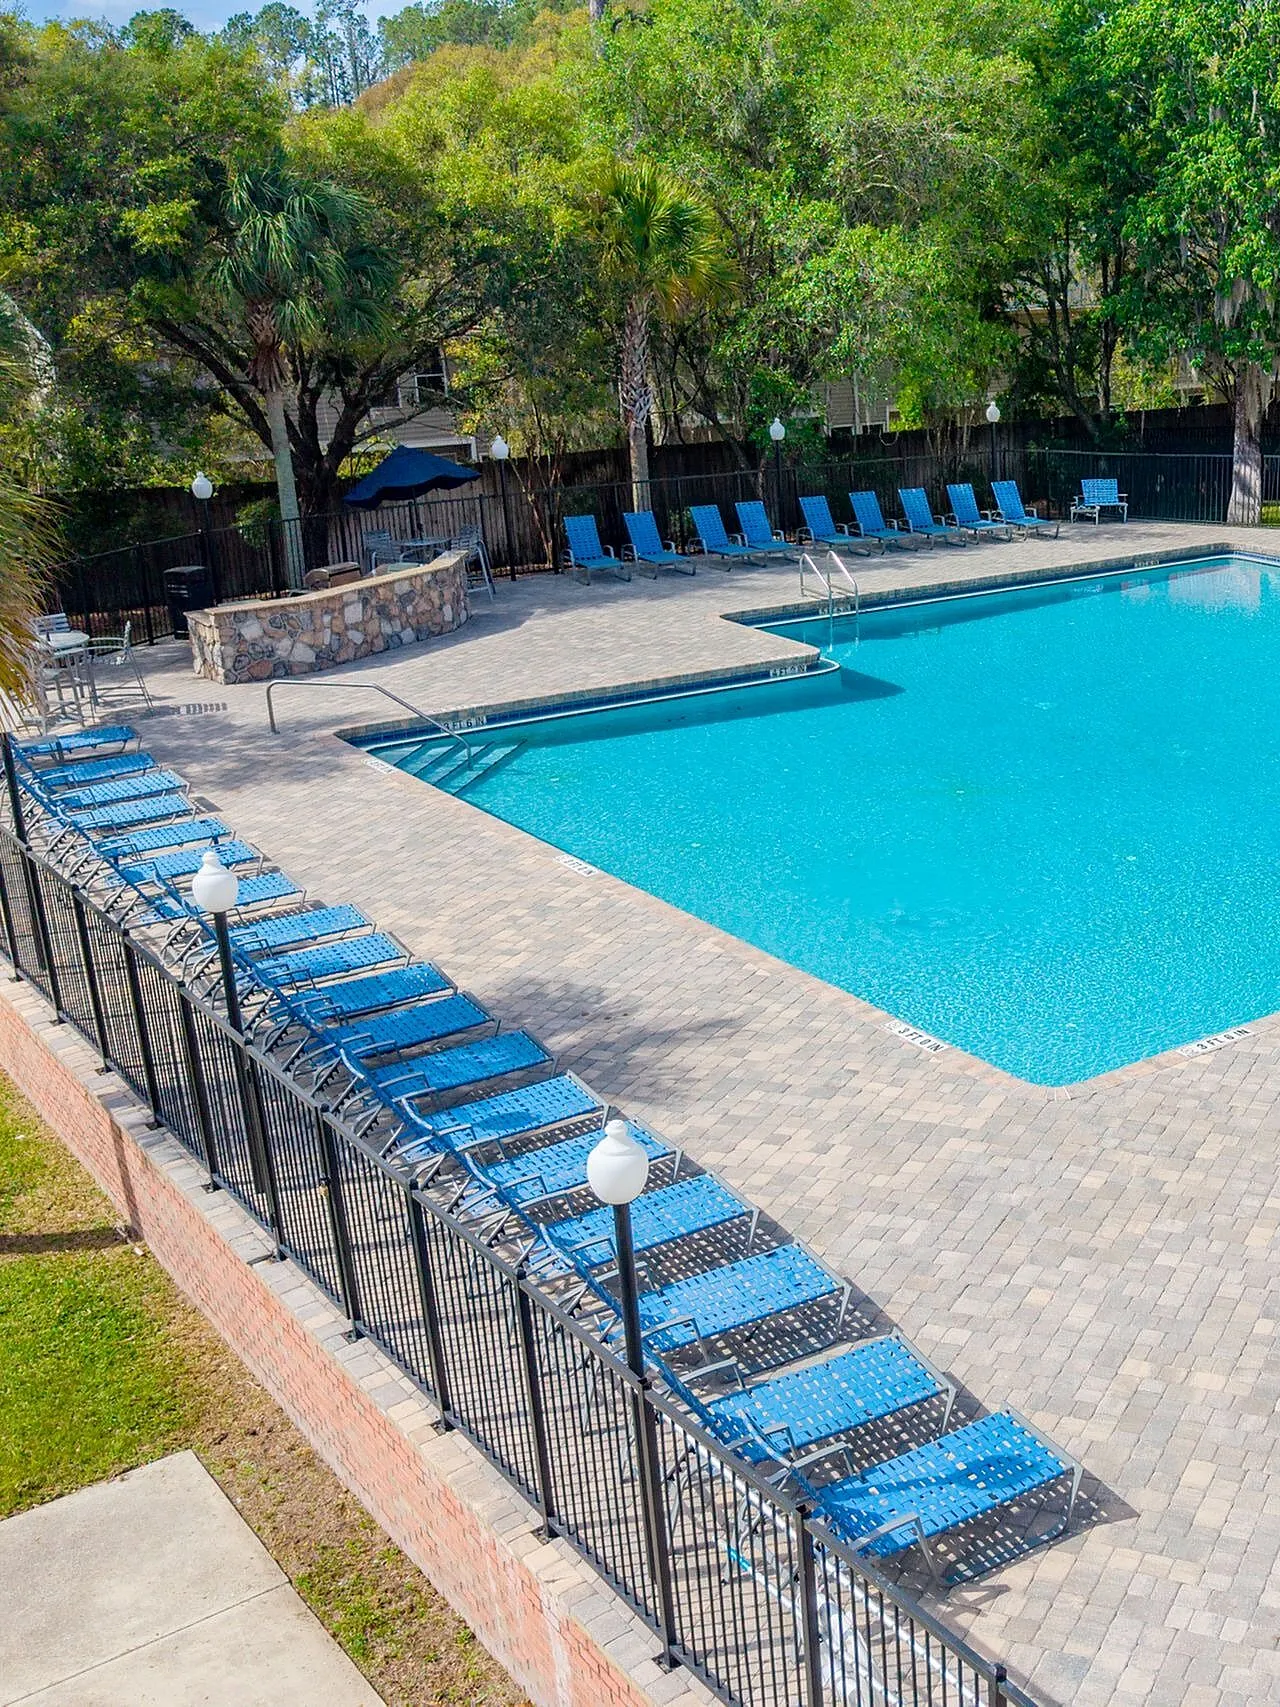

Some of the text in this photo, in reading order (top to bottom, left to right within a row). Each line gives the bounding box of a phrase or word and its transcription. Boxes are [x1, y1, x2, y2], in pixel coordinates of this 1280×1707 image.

[905, 1031, 923, 1041] FT
[927, 1041, 944, 1052] IN
[1207, 1037, 1224, 1046] FT
[1234, 1028, 1251, 1037] IN
